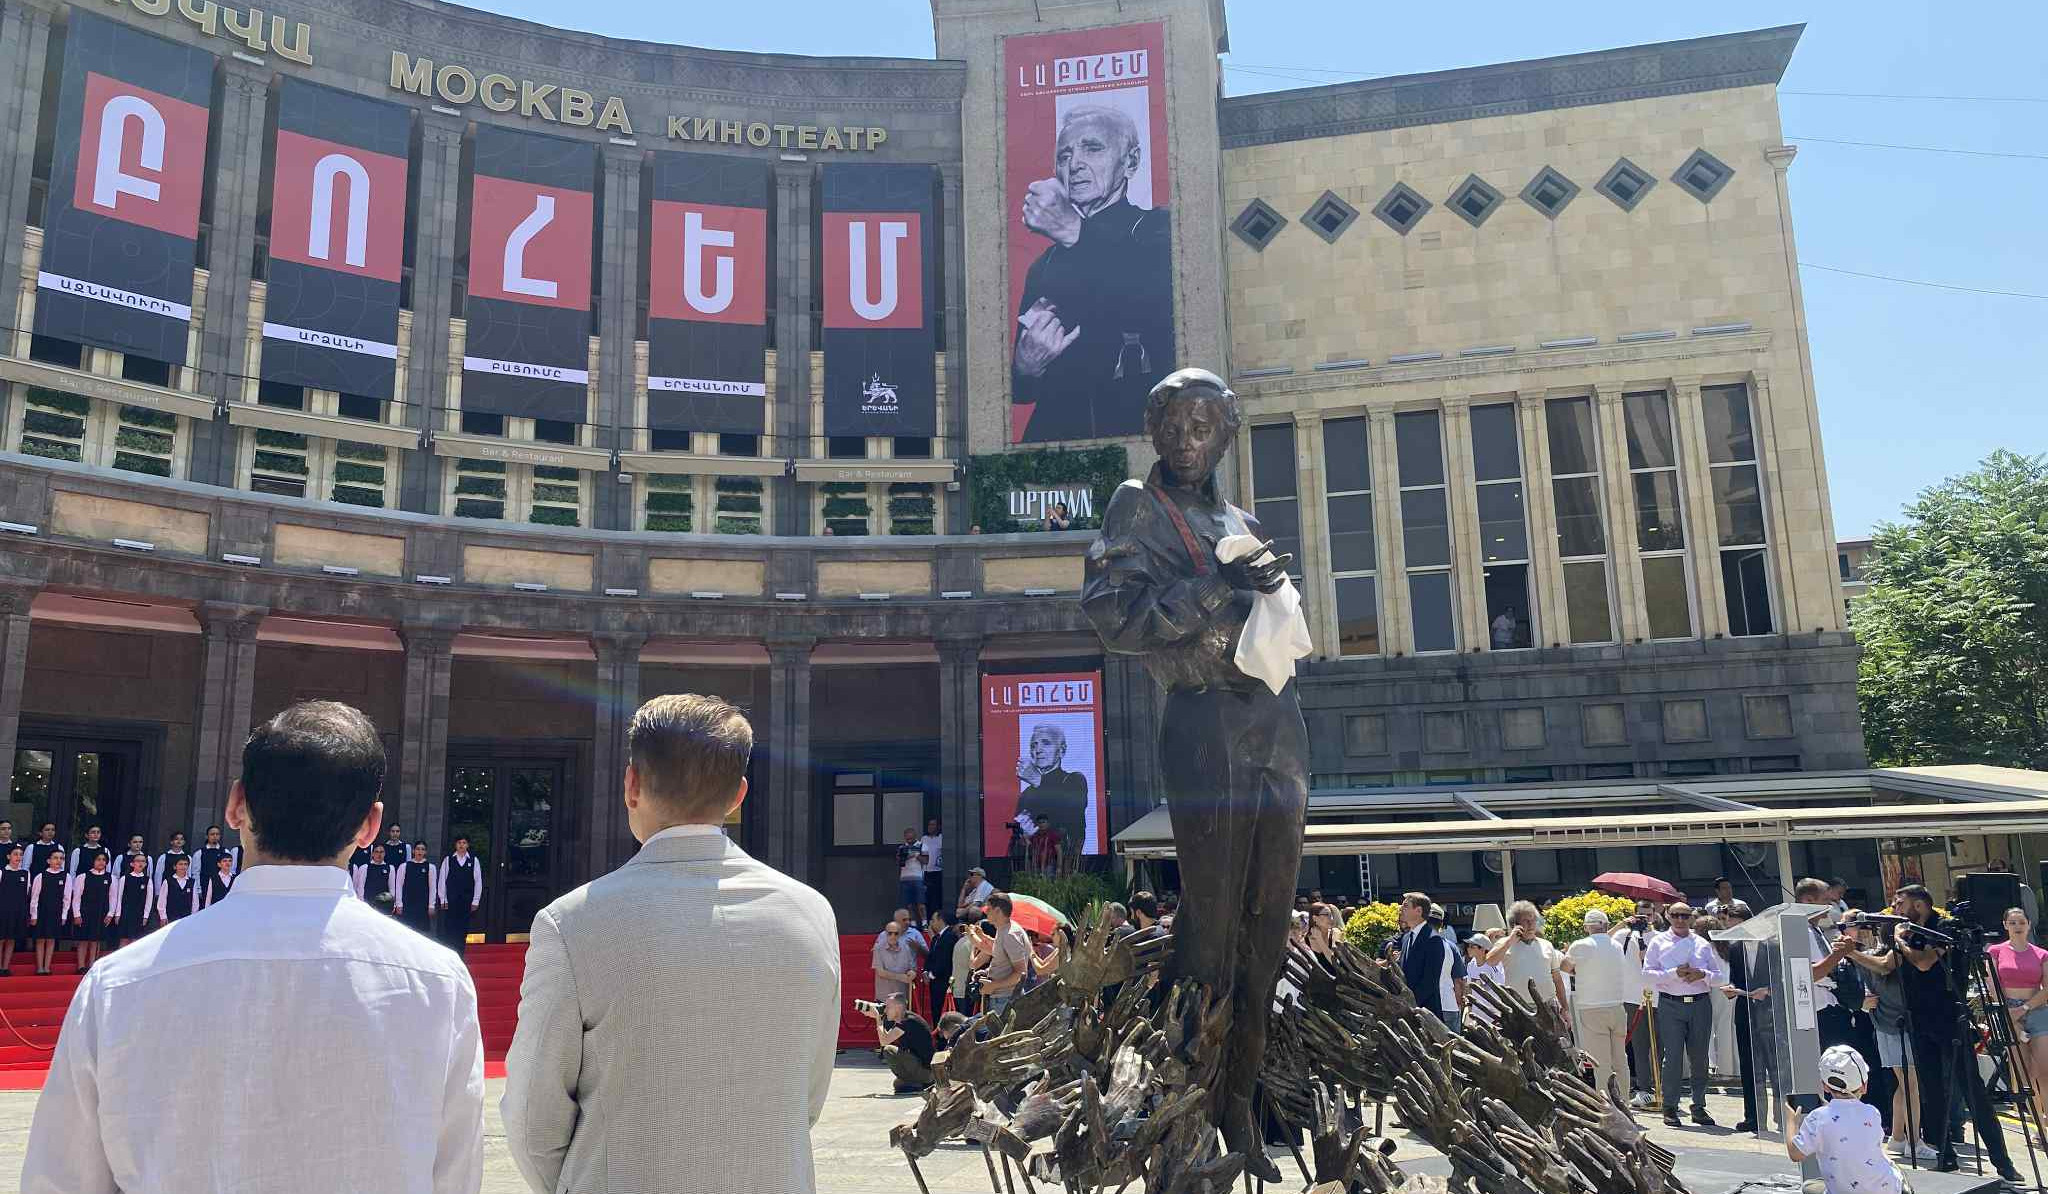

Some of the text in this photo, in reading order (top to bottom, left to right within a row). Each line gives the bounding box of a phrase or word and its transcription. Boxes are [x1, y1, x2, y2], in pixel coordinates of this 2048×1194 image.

[1019, 53, 1143, 87] ԼԱ ԲՈՀԵՄ
[390, 51, 633, 134] МОСКВА
[667, 115, 887, 151] КИНОТЕАТР
[60, 279, 171, 312] ԱԶՆԱՎՈՒՐԻ
[299, 331, 364, 350] ԱՐՁԱՆԻ
[492, 362, 562, 378] ԲԱՑՈՒՄԸ
[664, 380, 750, 392] ԵՐԵՎԱՆՈՒՄ
[1010, 488, 1092, 519] UPTOWN
[990, 683, 1089, 705] ԼԱ ԲՈՀԵՄ
